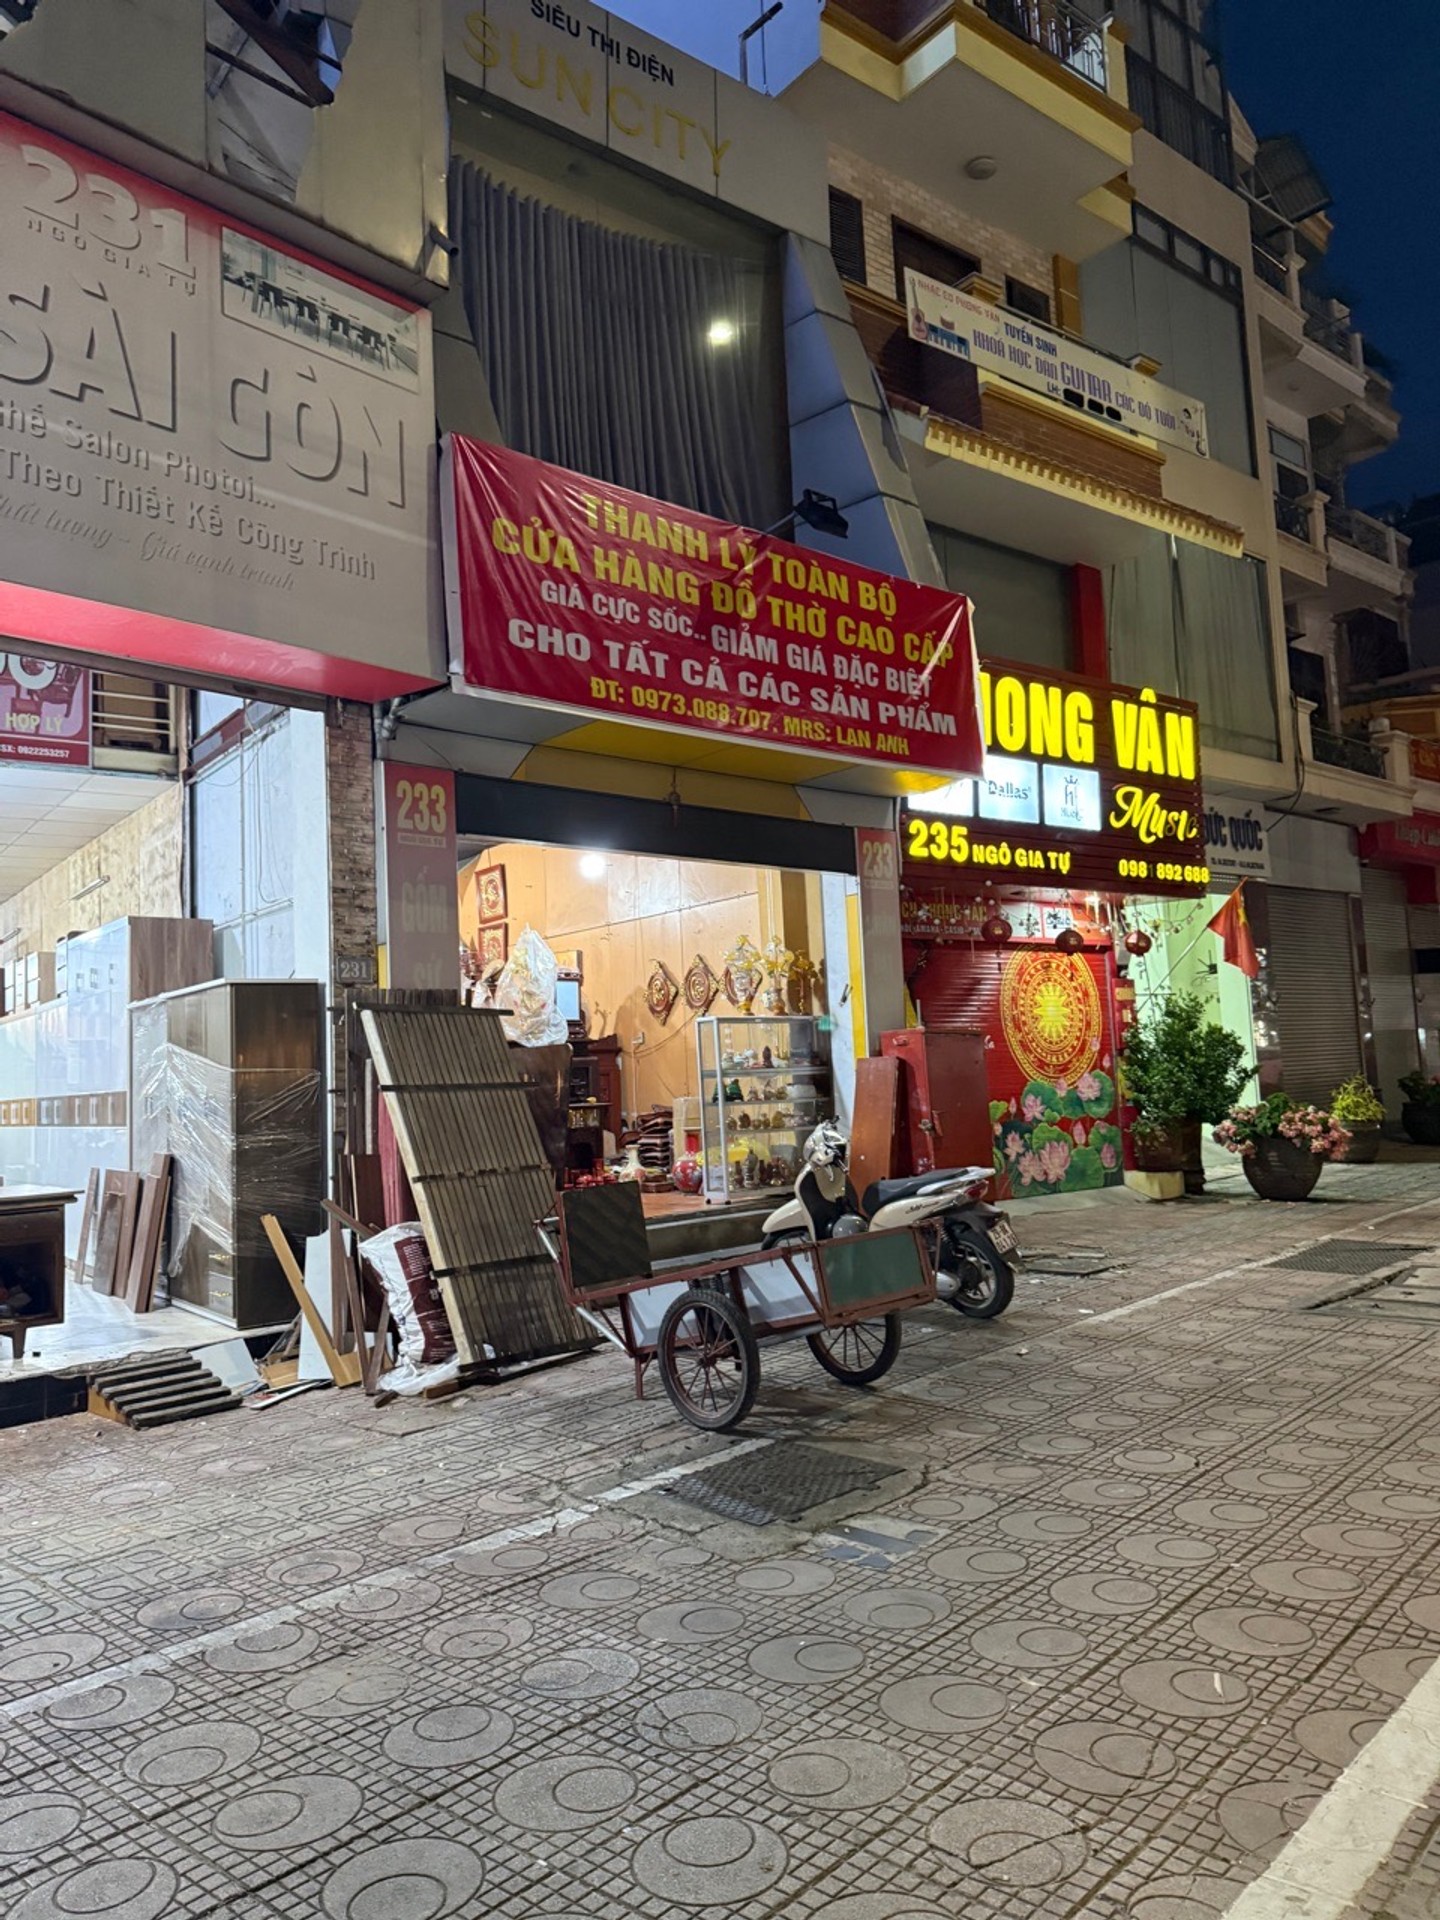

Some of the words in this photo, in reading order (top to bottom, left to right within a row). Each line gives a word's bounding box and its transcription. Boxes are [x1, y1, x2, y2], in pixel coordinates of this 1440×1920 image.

[531, 0, 580, 38] SIÊU
[587, 26, 620, 65] THỊ
[627, 47, 675, 87] ĐIỆN
[19, 142, 197, 282] 231
[1035, 336, 1058, 358] SINH
[1060, 361, 1112, 404] GUITAR
[64, 419, 150, 470] Salon
[212, 362, 408, 509] GÒN
[8, 450, 82, 497] Theo
[97, 476, 176, 524] Thiết
[239, 517, 304, 566] Công
[579, 492, 709, 562] THANH
[719, 536, 757, 576] LÝ
[767, 550, 850, 605] TOÀN
[858, 580, 898, 623] BỘ
[491, 516, 582, 574] CỬA
[593, 545, 700, 606] HÀNG
[711, 578, 758, 620] ĐỒ
[766, 595, 827, 639] THỜ
[836, 614, 895, 656] CAO
[904, 629, 954, 668] CẤP
[540, 579, 586, 611] GIÁ
[592, 592, 641, 625] CỰC
[711, 622, 780, 666] GIẢM
[786, 644, 828, 677] GIÁ
[833, 653, 880, 690] ĐẶC
[885, 666, 933, 700] BIỆT
[508, 618, 592, 662] CHO
[603, 639, 670, 680] TẤT
[681, 656, 729, 693] CẢ
[738, 670, 801, 707] CÁC
[809, 684, 871, 722] SẢN
[878, 700, 958, 737] PHẨM
[5, 711, 41, 732] HỢP
[44, 714, 65, 733] LÝ
[590, 676, 624, 704] ĐT:
[783, 715, 833, 743] MRS:
[836, 725, 872, 749] LAN
[876, 733, 911, 756] ANH
[1111, 686, 1196, 780] VÂN
[396, 779, 448, 834] 233
[987, 779, 1031, 801] Dallas
[1109, 785, 1198, 844] Music
[908, 818, 970, 864] 235
[972, 841, 1012, 867] NGÔ
[1014, 847, 1046, 870] GIA
[1047, 850, 1071, 875] TỰ
[1228, 808, 1264, 853] QUỐC
[862, 840, 894, 880] 233
[1156, 861, 1184, 881] 892
[1184, 864, 1211, 884] 688
[339, 960, 368, 978] 231
